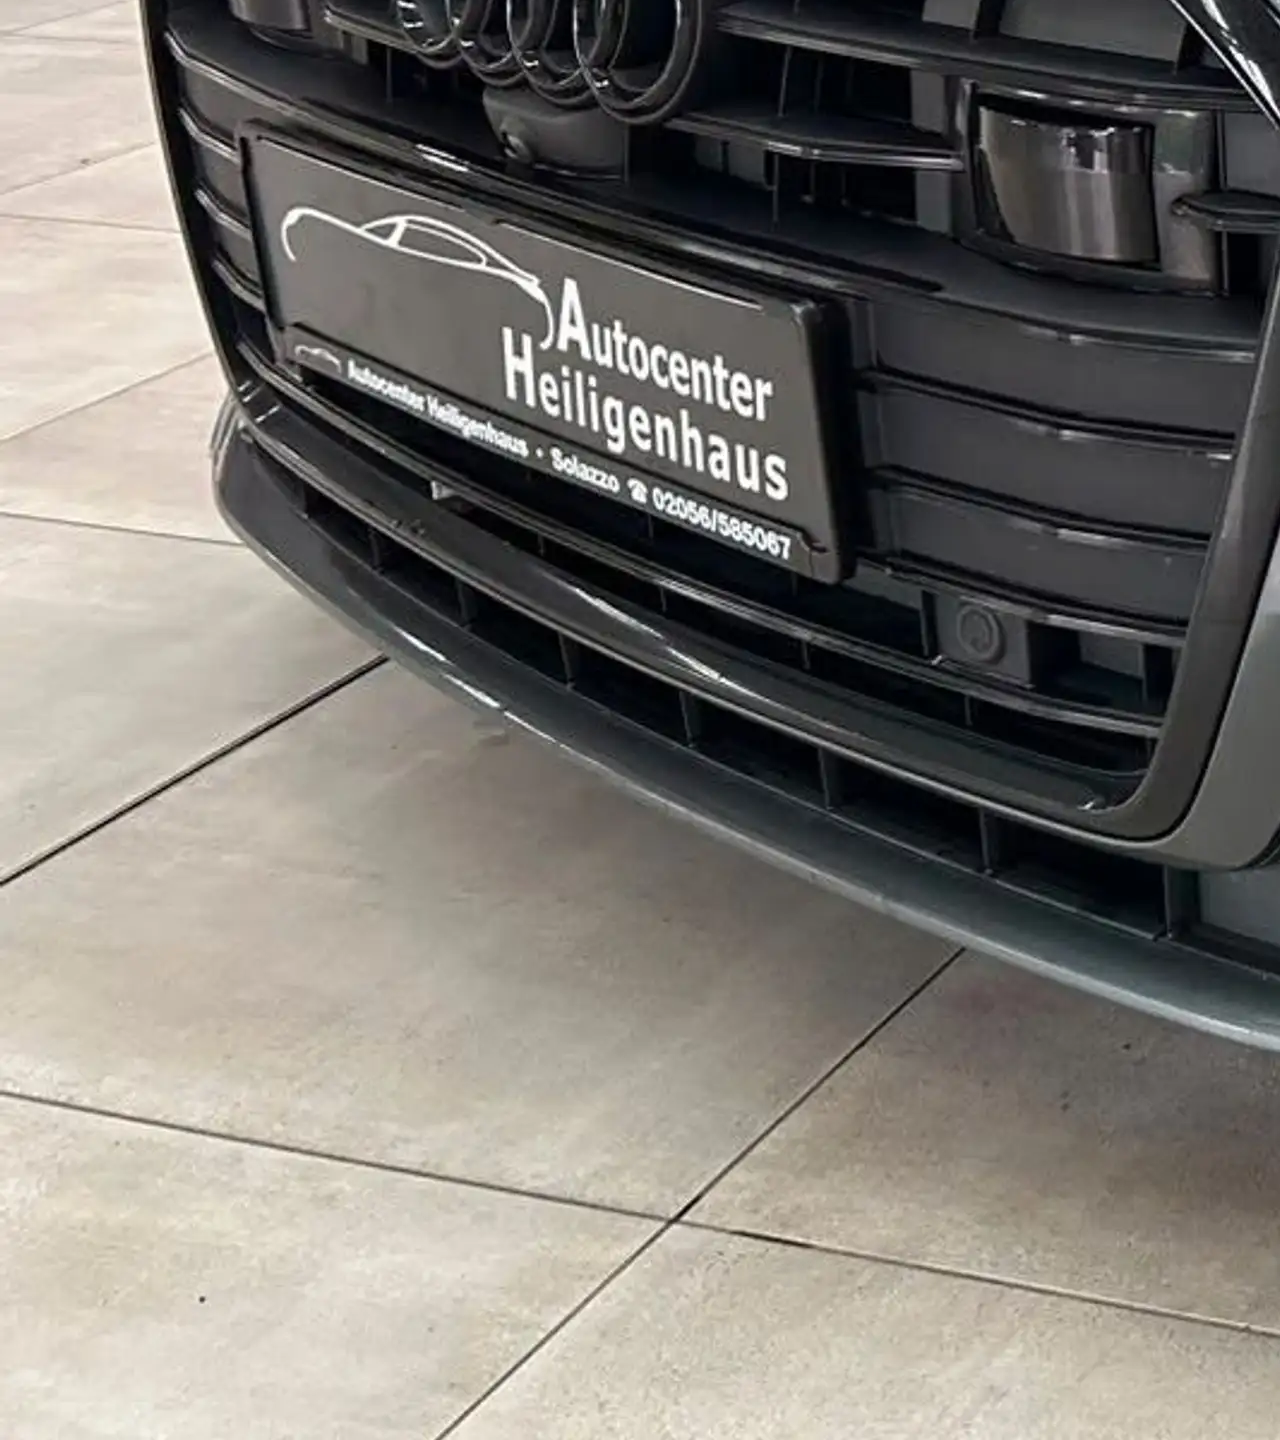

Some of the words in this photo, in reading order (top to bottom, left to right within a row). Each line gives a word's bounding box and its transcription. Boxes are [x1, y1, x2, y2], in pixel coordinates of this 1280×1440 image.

[502, 326, 789, 501] Heiligenhaus
[557, 277, 773, 421] Autocenter
[427, 394, 530, 458] Heiligenhaus
[551, 447, 621, 494] Solazzo
[652, 486, 791, 560] 02056/585067
